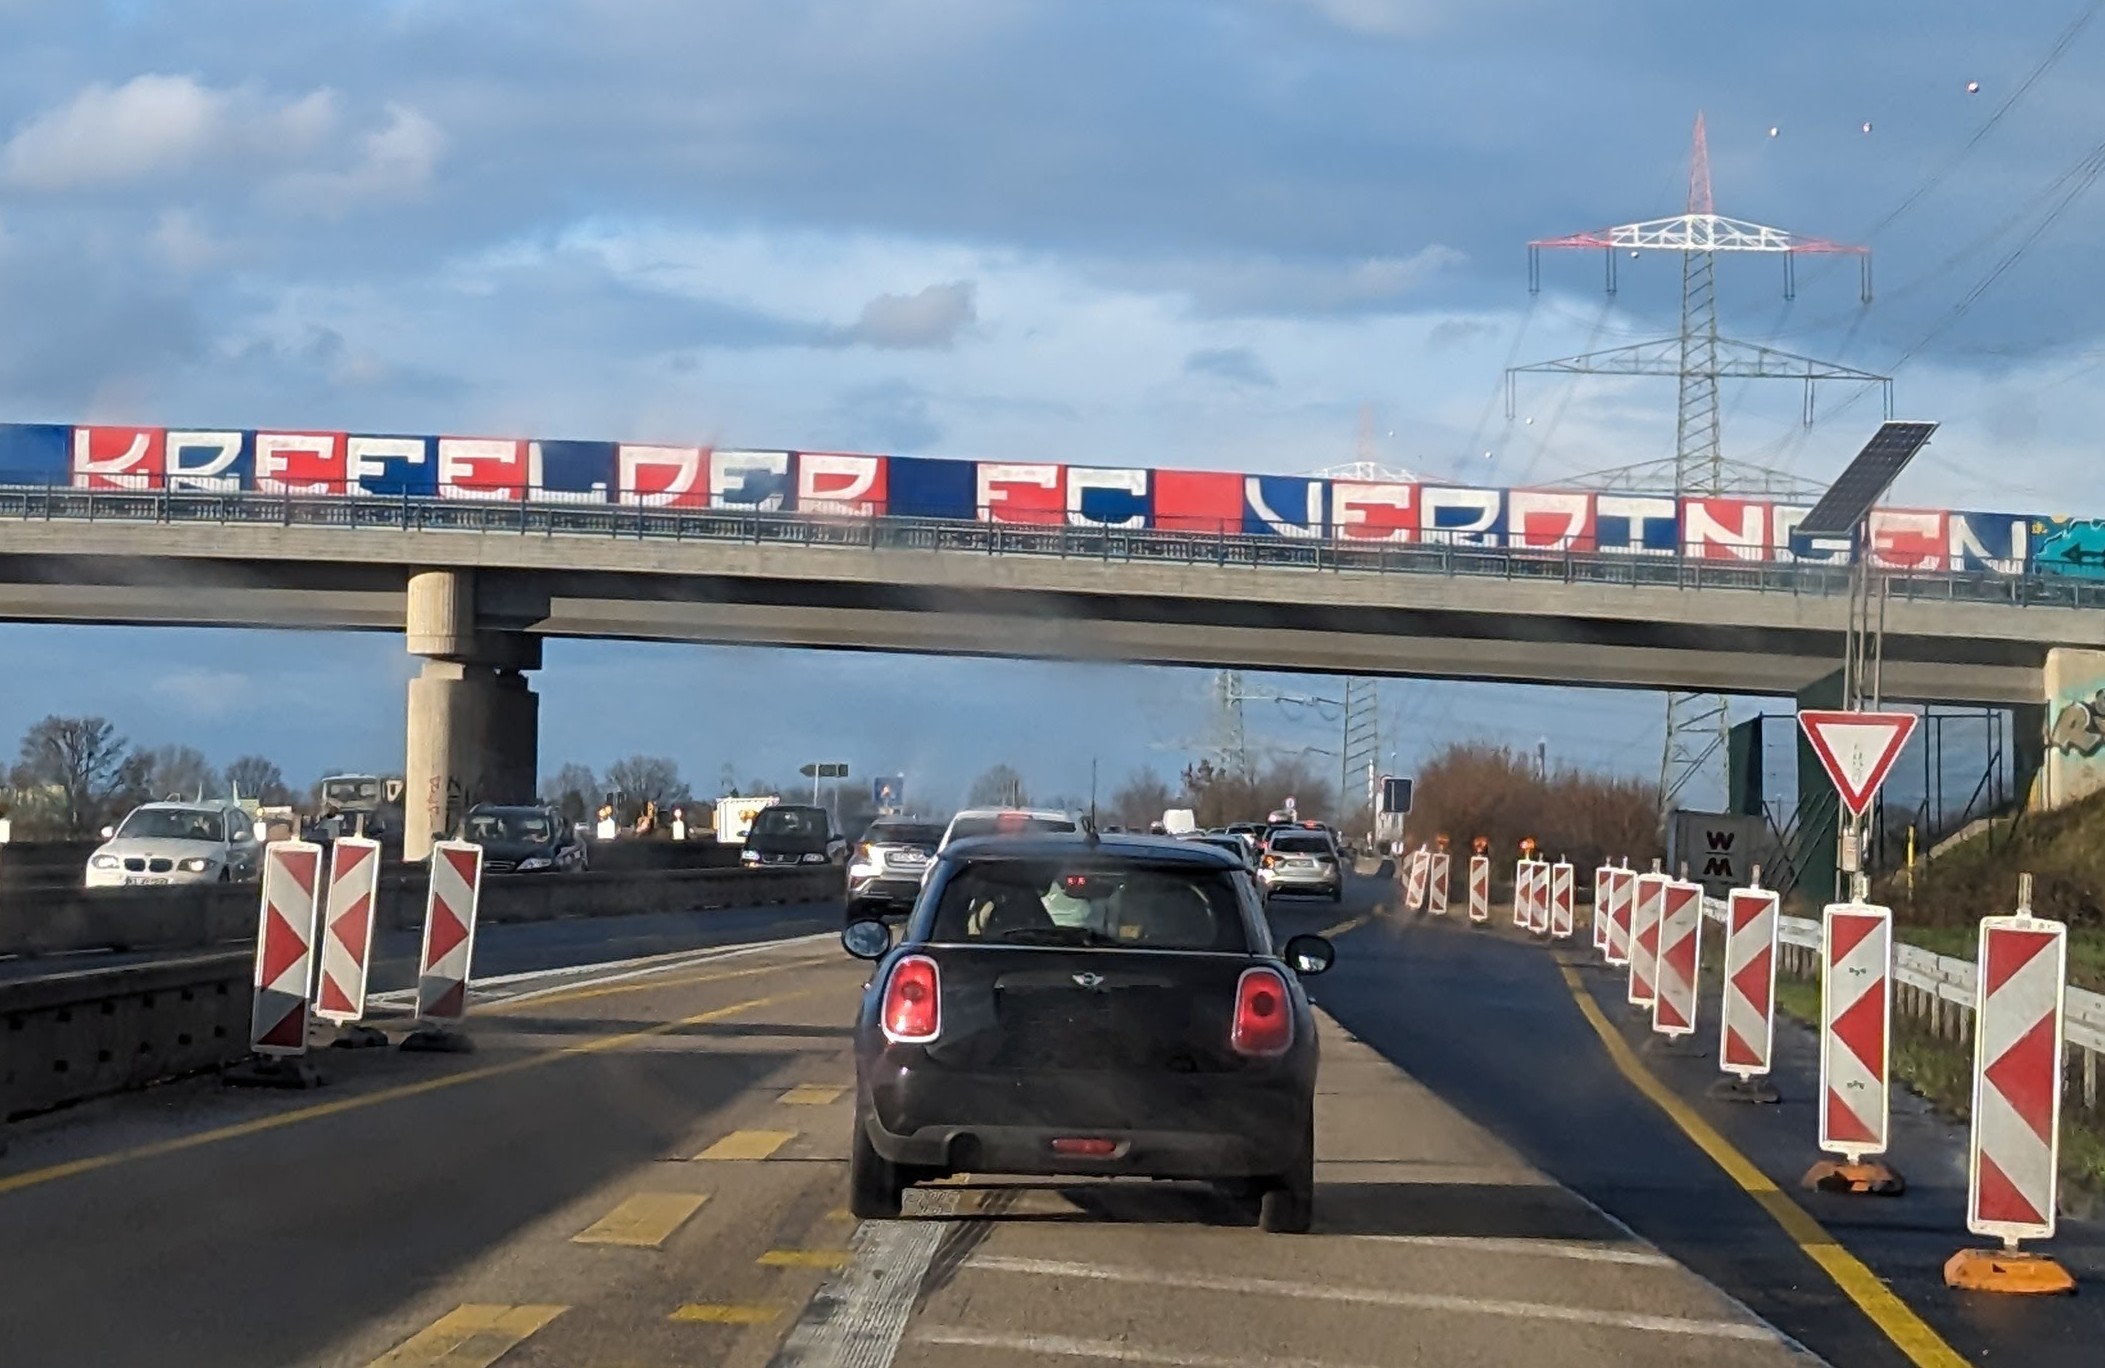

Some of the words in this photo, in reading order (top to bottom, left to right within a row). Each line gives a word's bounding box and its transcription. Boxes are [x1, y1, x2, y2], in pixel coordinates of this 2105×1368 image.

[74, 428, 877, 517] KREFELDER
[976, 463, 1147, 529] FC
[1245, 476, 2027, 575] UERDINGEN
